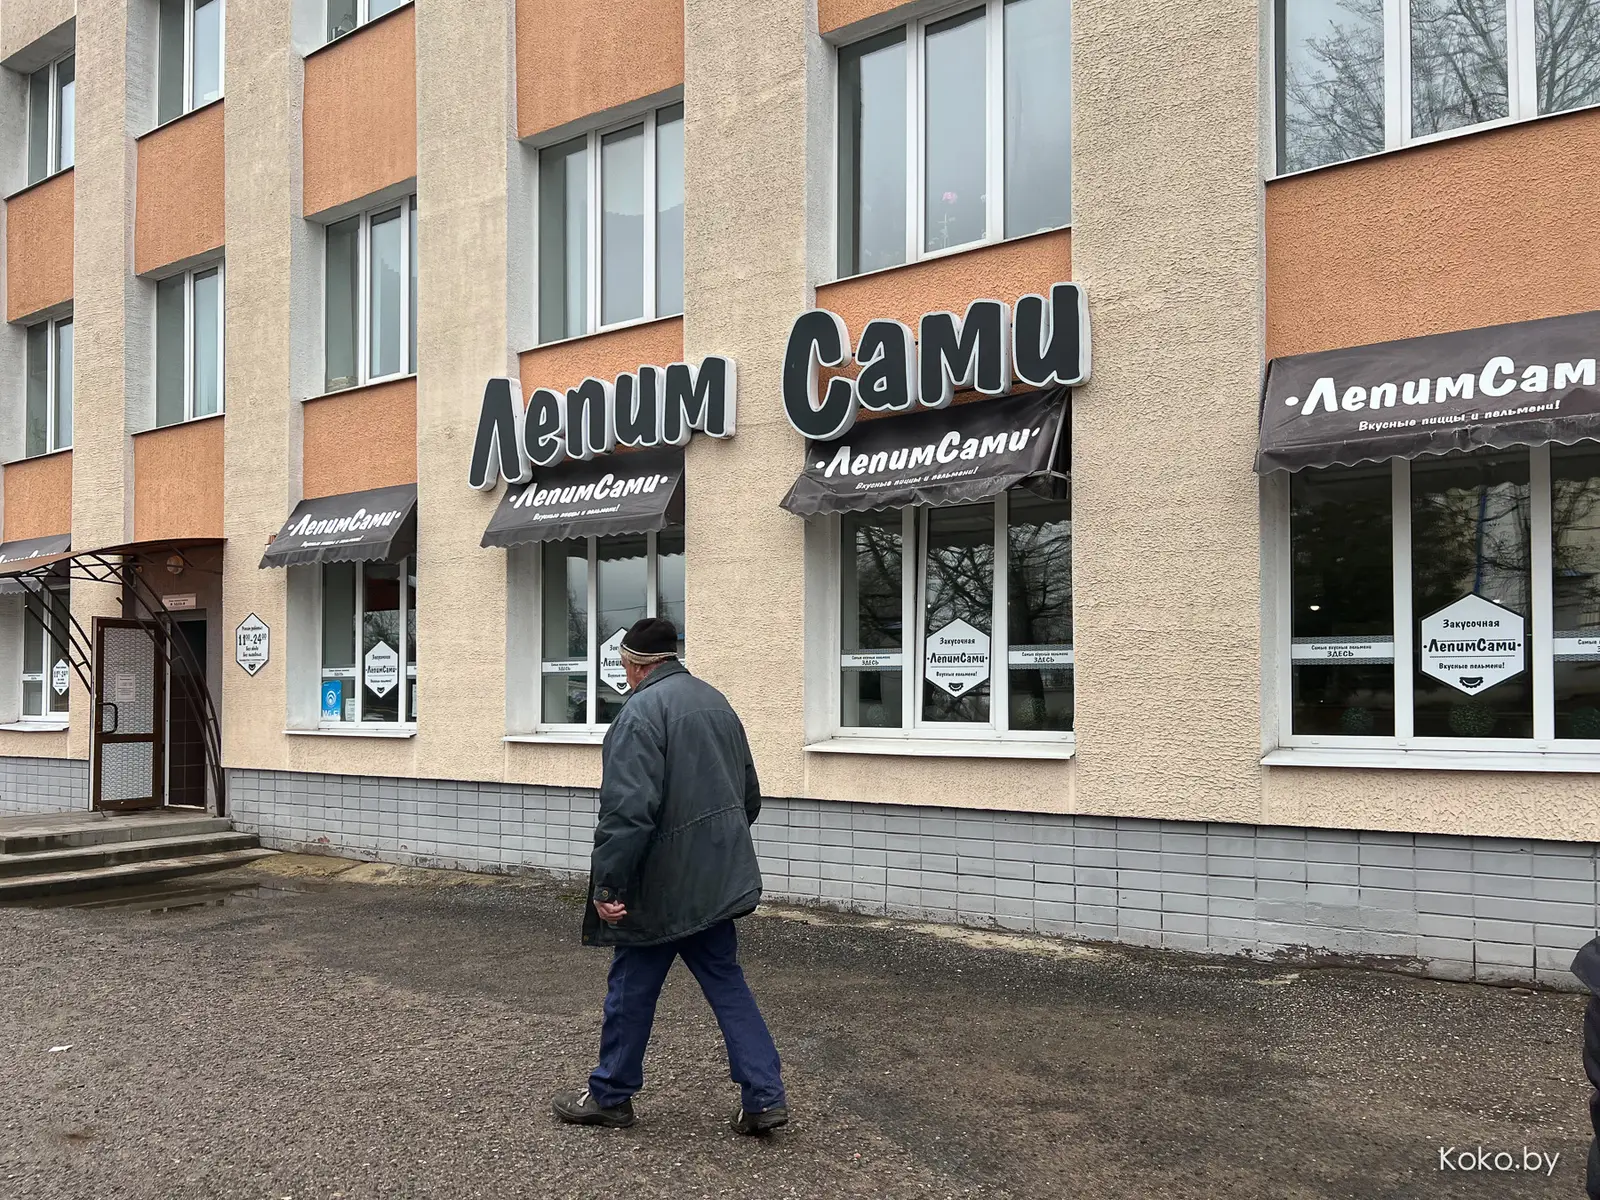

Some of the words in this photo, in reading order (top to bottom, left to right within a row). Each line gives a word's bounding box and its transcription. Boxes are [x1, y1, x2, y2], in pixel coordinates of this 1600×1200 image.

[468, 355, 737, 491] Лепим
[782, 282, 1091, 441] Сами
[1358, 419, 1416, 432] Вкусные
[1421, 413, 1465, 426] пиццы
[1471, 413, 1479, 421] и
[1484, 400, 1561, 419] пельмени!
[824, 428, 1031, 478] ЛепимСами
[513, 474, 660, 509] ЛепимСами
[289, 508, 397, 537] ЛепимСами
[1443, 619, 1500, 630] Закусочная
[939, 636, 976, 646] Закусочная
[1428, 638, 1516, 652] ЛепимСами
[930, 652, 985, 664] ЛепимСами
[1327, 650, 1354, 658] ЗДЕСЬ
[1439, 662, 1468, 671] Вкусные
[1469, 662, 1505, 670] пельмени!
